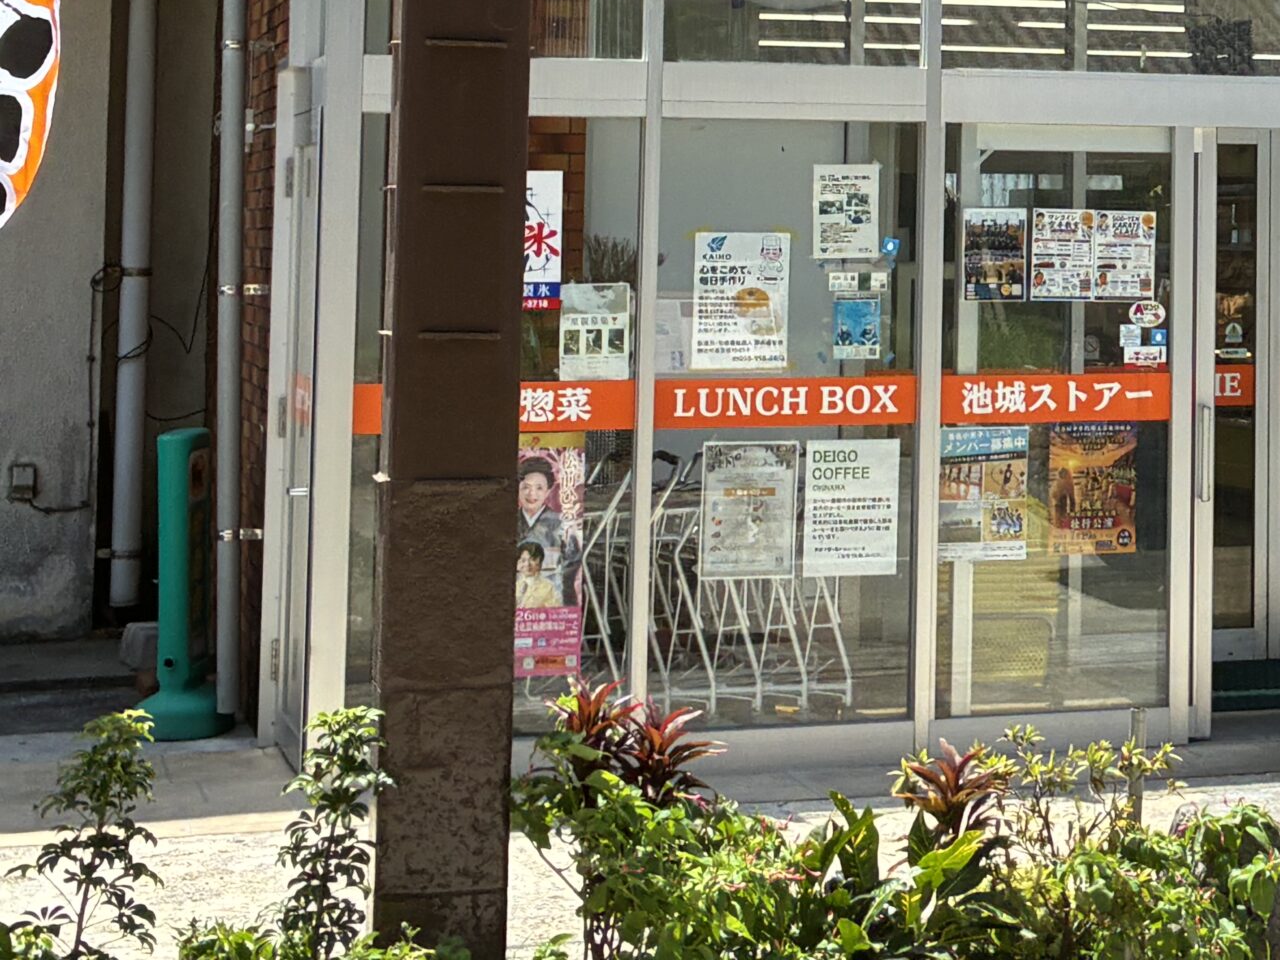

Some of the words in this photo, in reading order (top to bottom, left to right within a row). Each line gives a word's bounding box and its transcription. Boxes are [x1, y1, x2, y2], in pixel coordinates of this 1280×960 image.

[524, 221, 561, 258] 氷
[520, 387, 593, 423] 惣菜
[673, 386, 811, 418] LUNCH
[819, 384, 899, 415] BOX
[961, 380, 1154, 415] 池城ストアー
[812, 450, 858, 463] DEIGO
[812, 466, 870, 480] COFFEE
